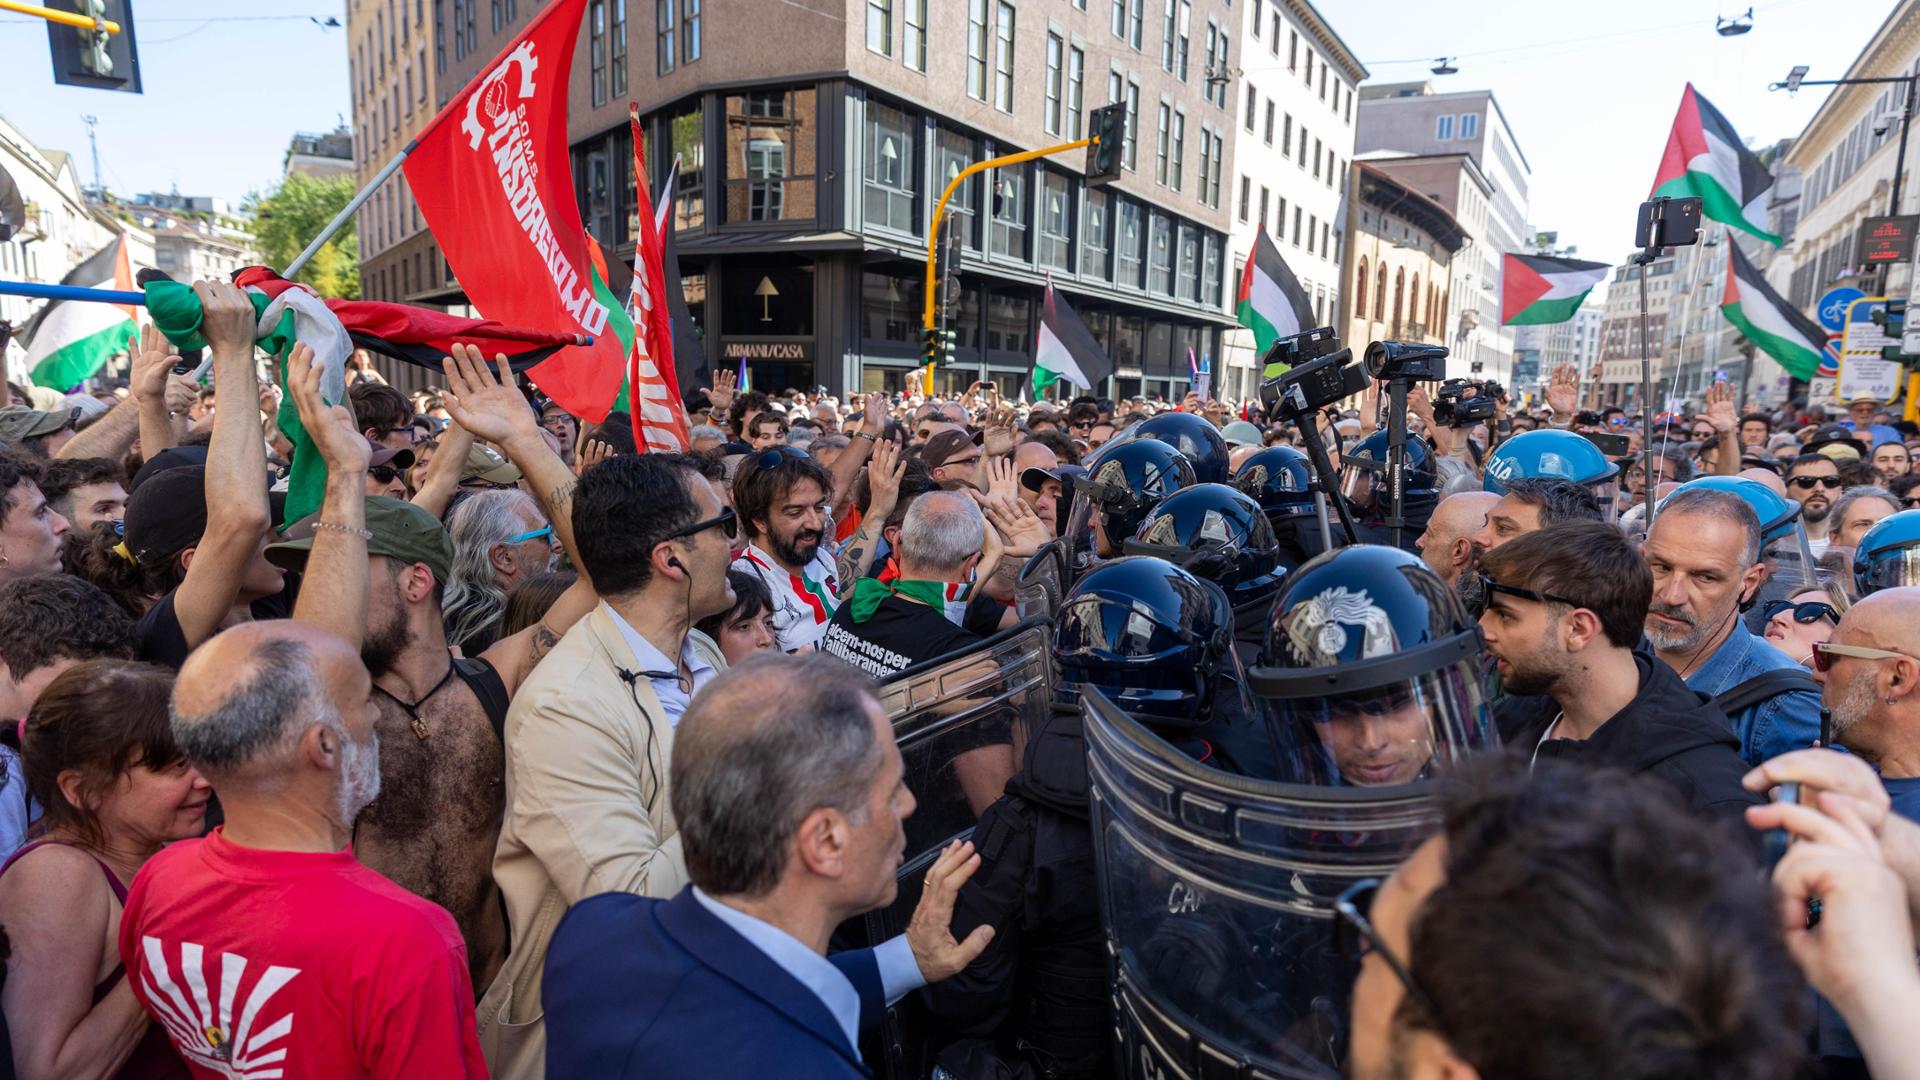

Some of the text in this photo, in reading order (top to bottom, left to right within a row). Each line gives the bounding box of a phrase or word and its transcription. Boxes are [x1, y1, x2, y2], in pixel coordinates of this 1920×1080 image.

[516, 102, 537, 183] S.O.M.S.
[724, 343, 804, 358] ARMANI/CASA
[827, 623, 912, 670] alcem-nos per
